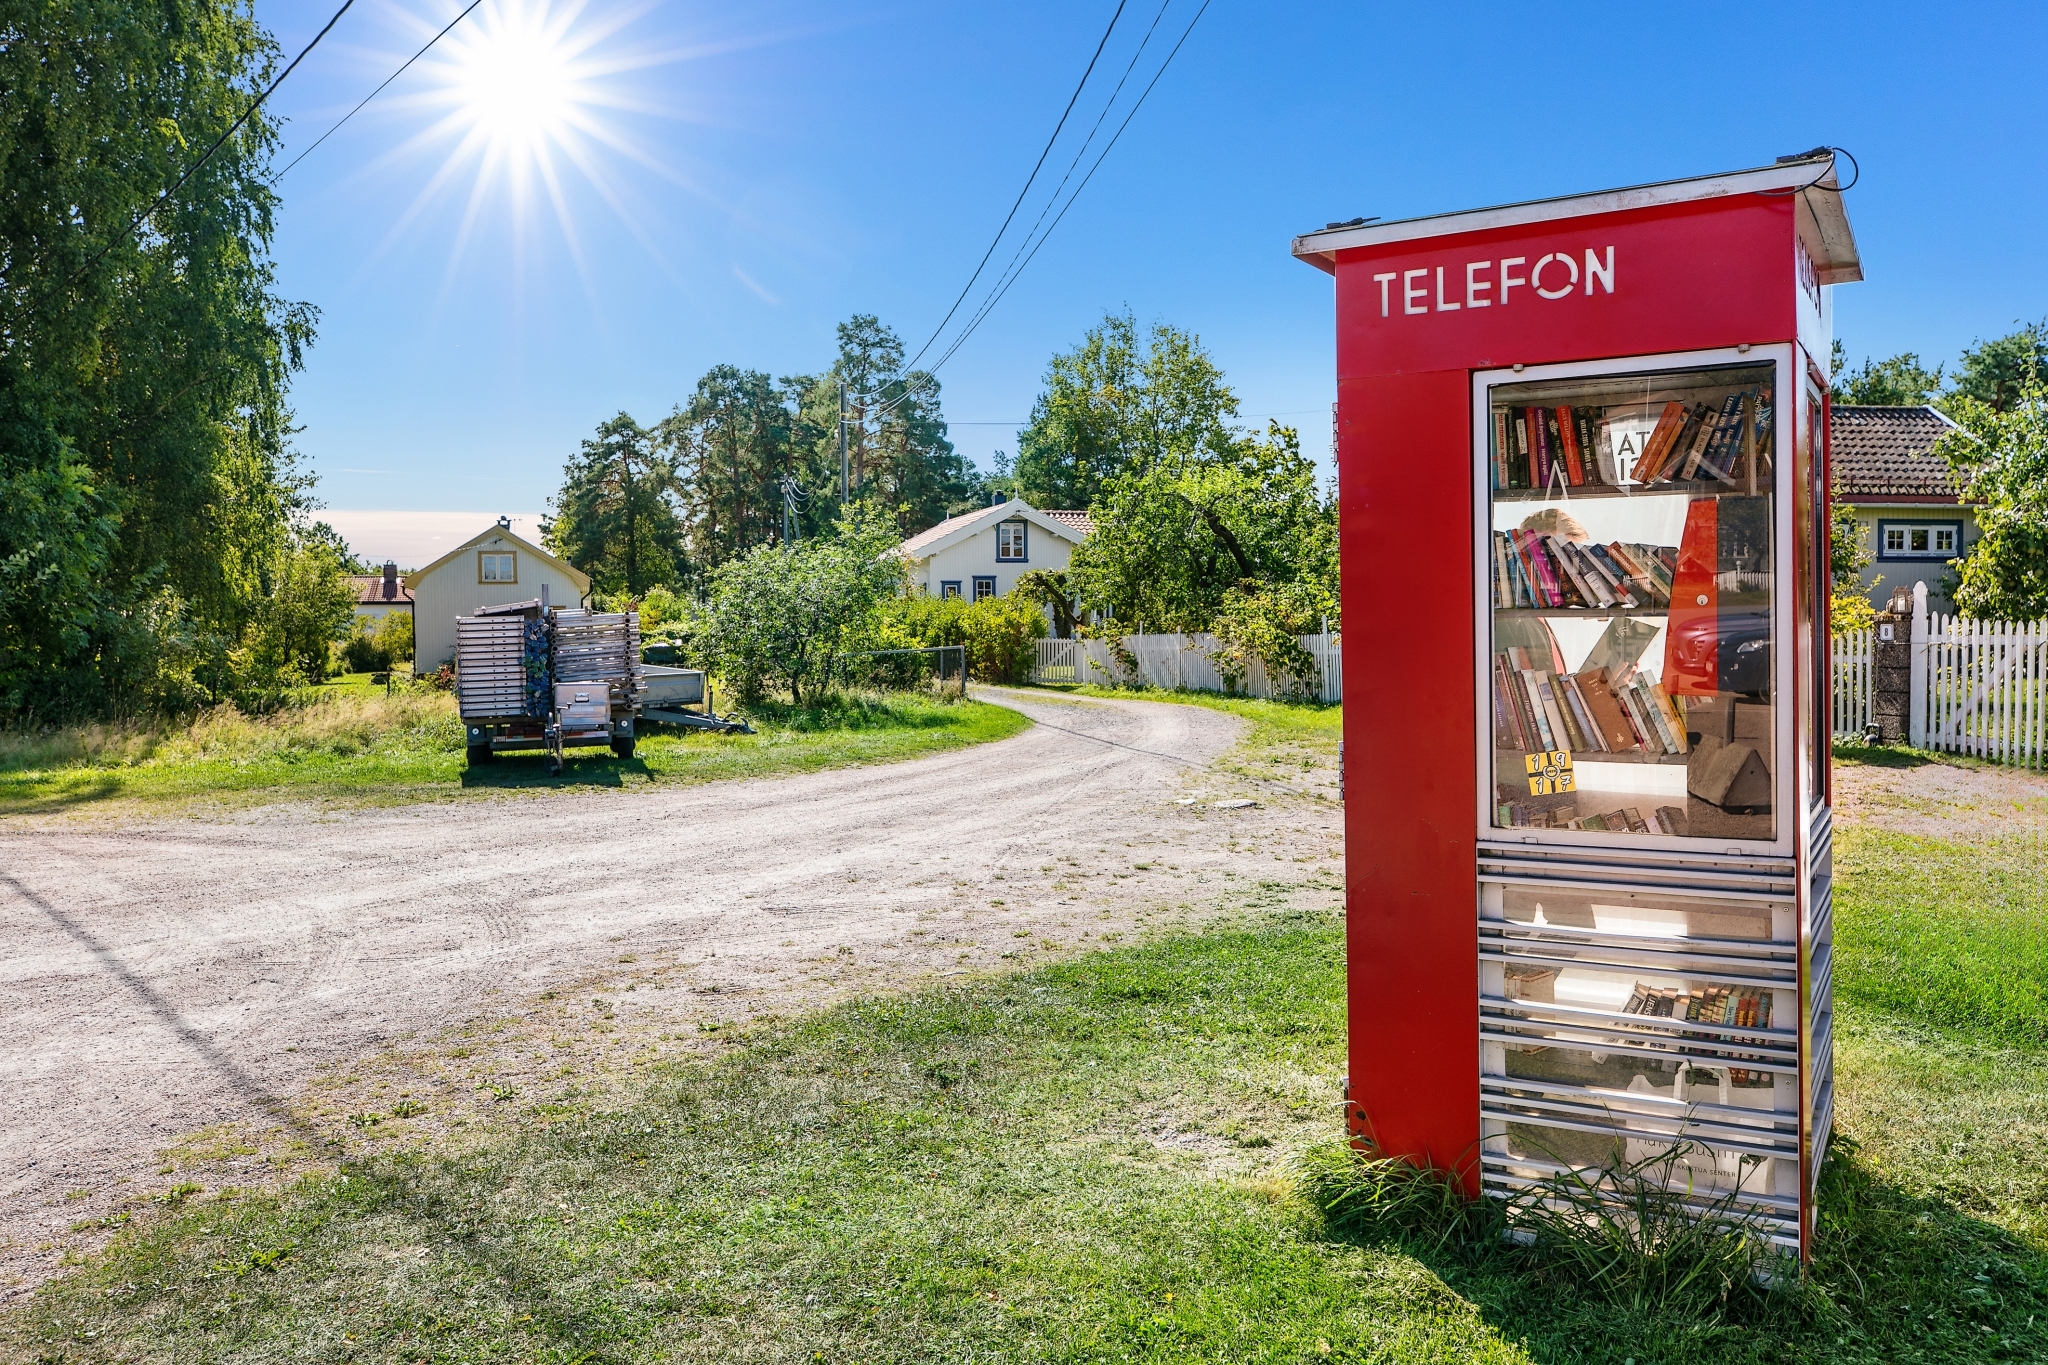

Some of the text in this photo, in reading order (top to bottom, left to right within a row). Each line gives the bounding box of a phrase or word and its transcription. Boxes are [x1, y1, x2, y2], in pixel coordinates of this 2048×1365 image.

[1373, 245, 1616, 318] TELEFON
[1717, 396, 1734, 427] LEON URIS
[1730, 410, 1741, 426] URIS
[1885, 627, 1888, 636] 8
[1644, 998, 1656, 1016] JENS
[1709, 1169, 1736, 1178] SENTER
